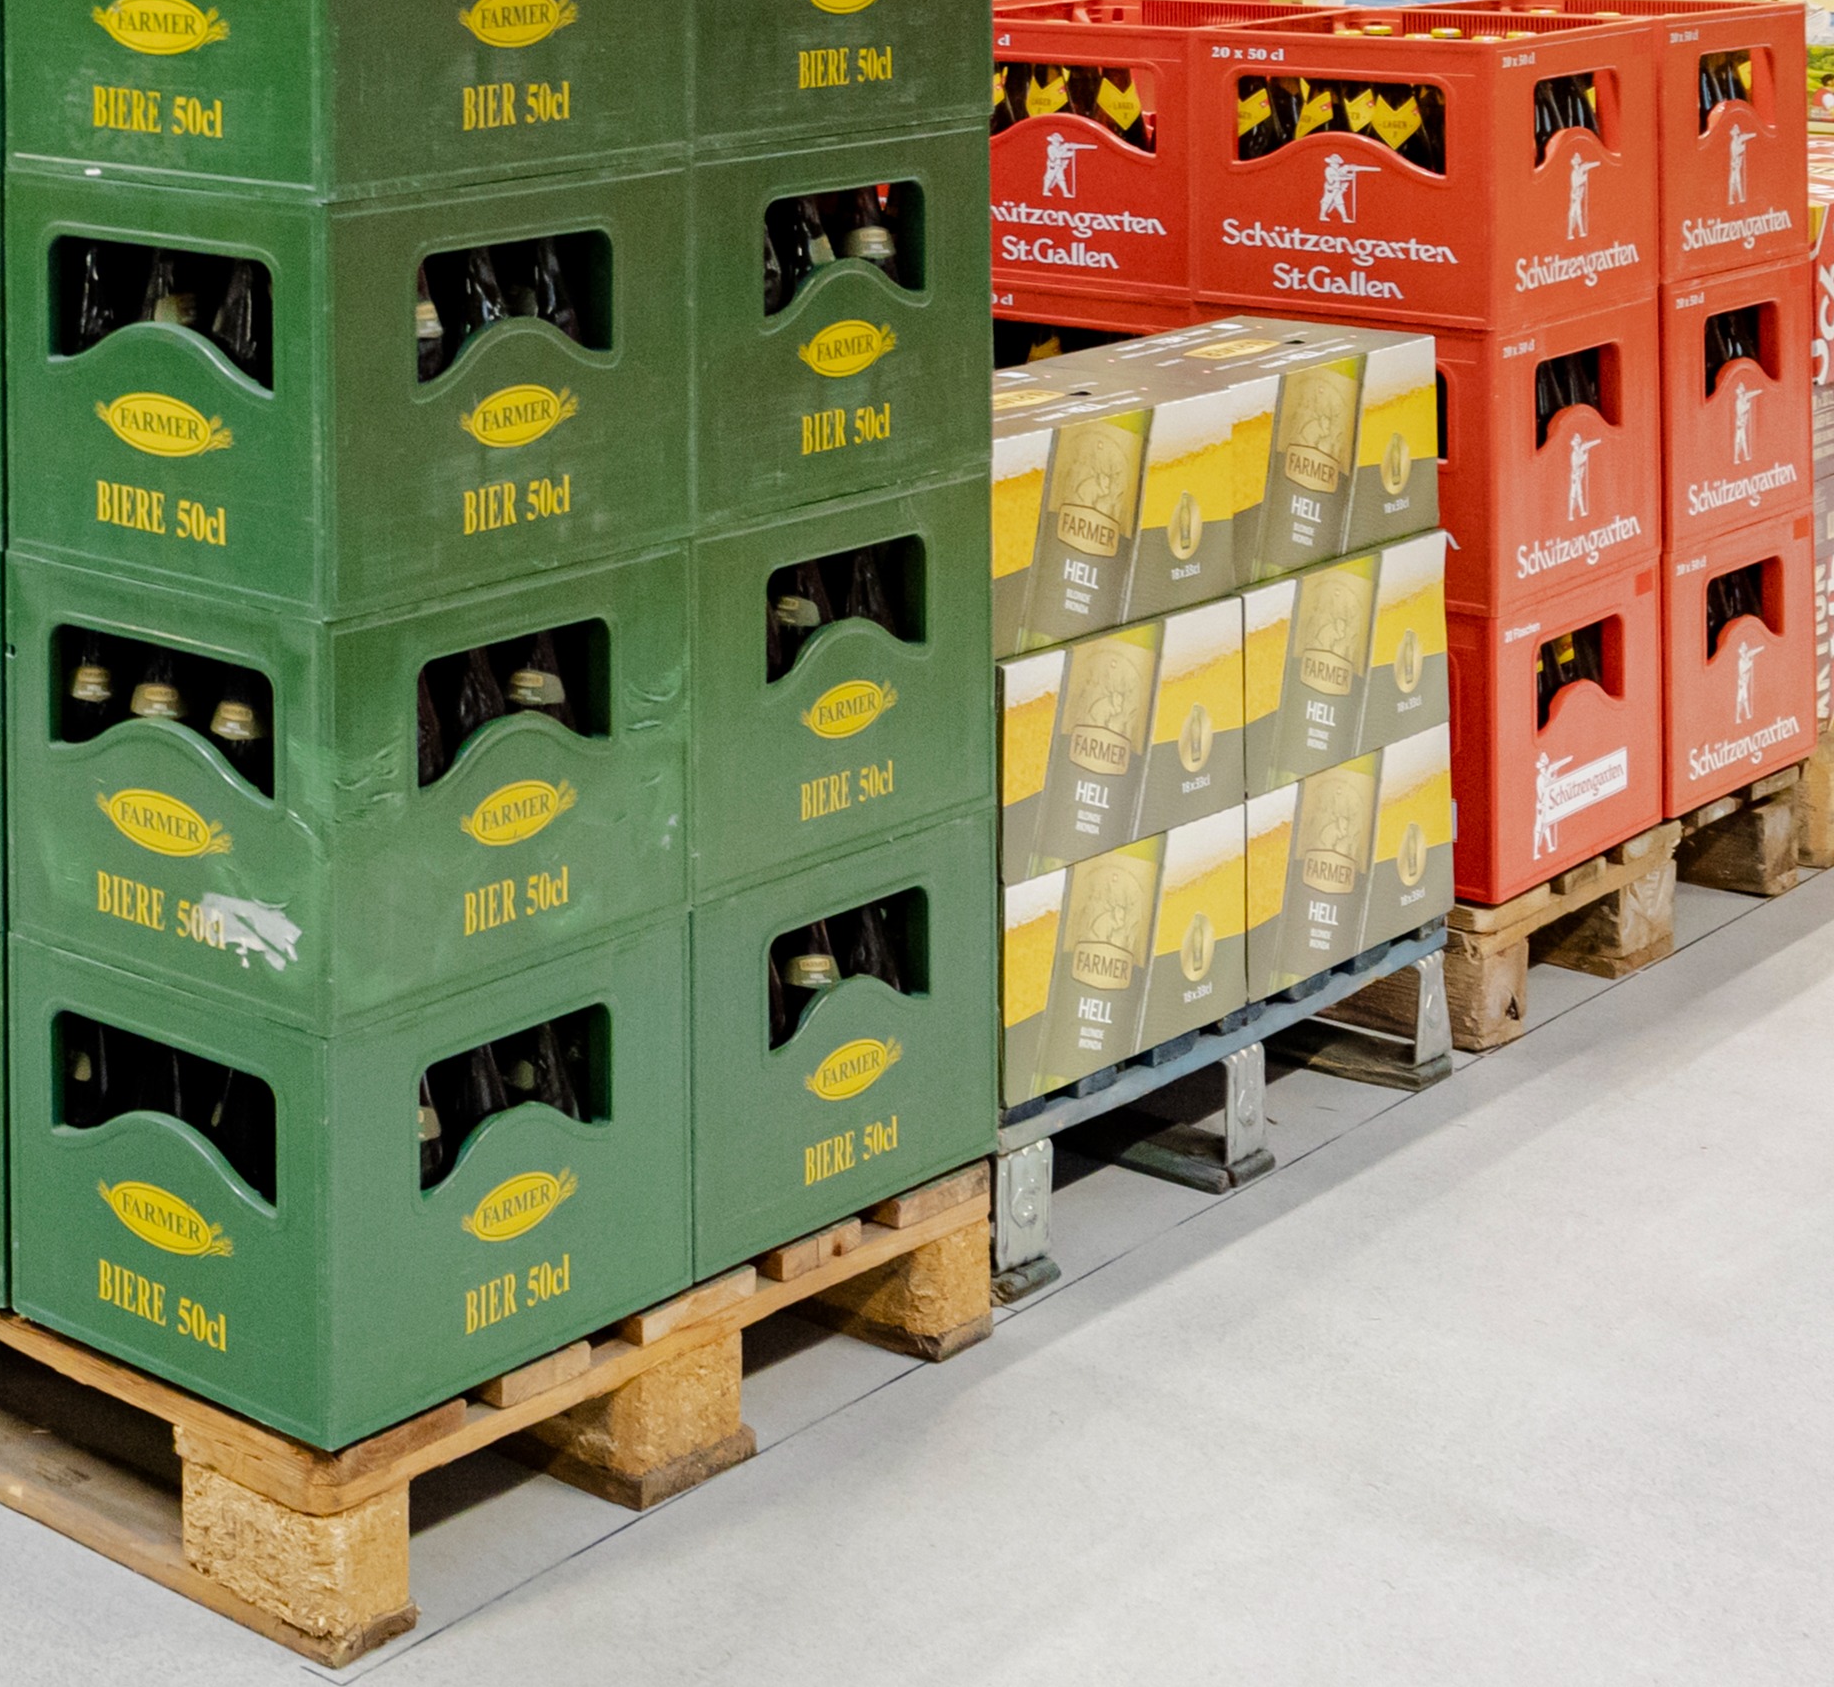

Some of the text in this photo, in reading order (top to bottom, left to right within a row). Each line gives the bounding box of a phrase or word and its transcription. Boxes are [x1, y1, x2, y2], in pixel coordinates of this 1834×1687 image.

[112, 6, 205, 40] FARMER
[797, 45, 894, 91] BIERE 50cl
[1211, 46, 1284, 61] 20 x 50 cl
[91, 84, 224, 139] BIERE 50cl
[1222, 218, 1458, 268] Schützengarten
[1682, 207, 1792, 251] Schützengarten
[1001, 235, 1120, 270] St.Gallen
[1515, 241, 1640, 293] Schützengarten
[1273, 262, 1404, 301] St.Gallen
[115, 403, 207, 446] FARMER
[1287, 453, 1337, 484] FARMER
[1290, 494, 1321, 523] HELL
[1688, 462, 1797, 517] Schützengarten
[95, 479, 228, 547] BIERE 50cl
[1061, 516, 1116, 549] FARMER
[1516, 515, 1641, 580] Schützengarten
[1063, 558, 1099, 591] HELL
[1304, 659, 1349, 686] FARMER
[1305, 700, 1336, 727] HELL
[1073, 735, 1126, 768] FARMER
[1688, 715, 1800, 782] Schützengarten
[1075, 781, 1109, 810] HELL
[1181, 774, 1211, 794] 18x33cl
[1547, 763, 1625, 812] Schützengarten
[477, 789, 554, 835] FARMER
[462, 864, 570, 938] BIER 50cl
[1076, 949, 1128, 982] FARMER
[1077, 998, 1112, 1025] HELL
[819, 1046, 883, 1091] FARMER
[803, 1114, 900, 1188] BIERE 50cl
